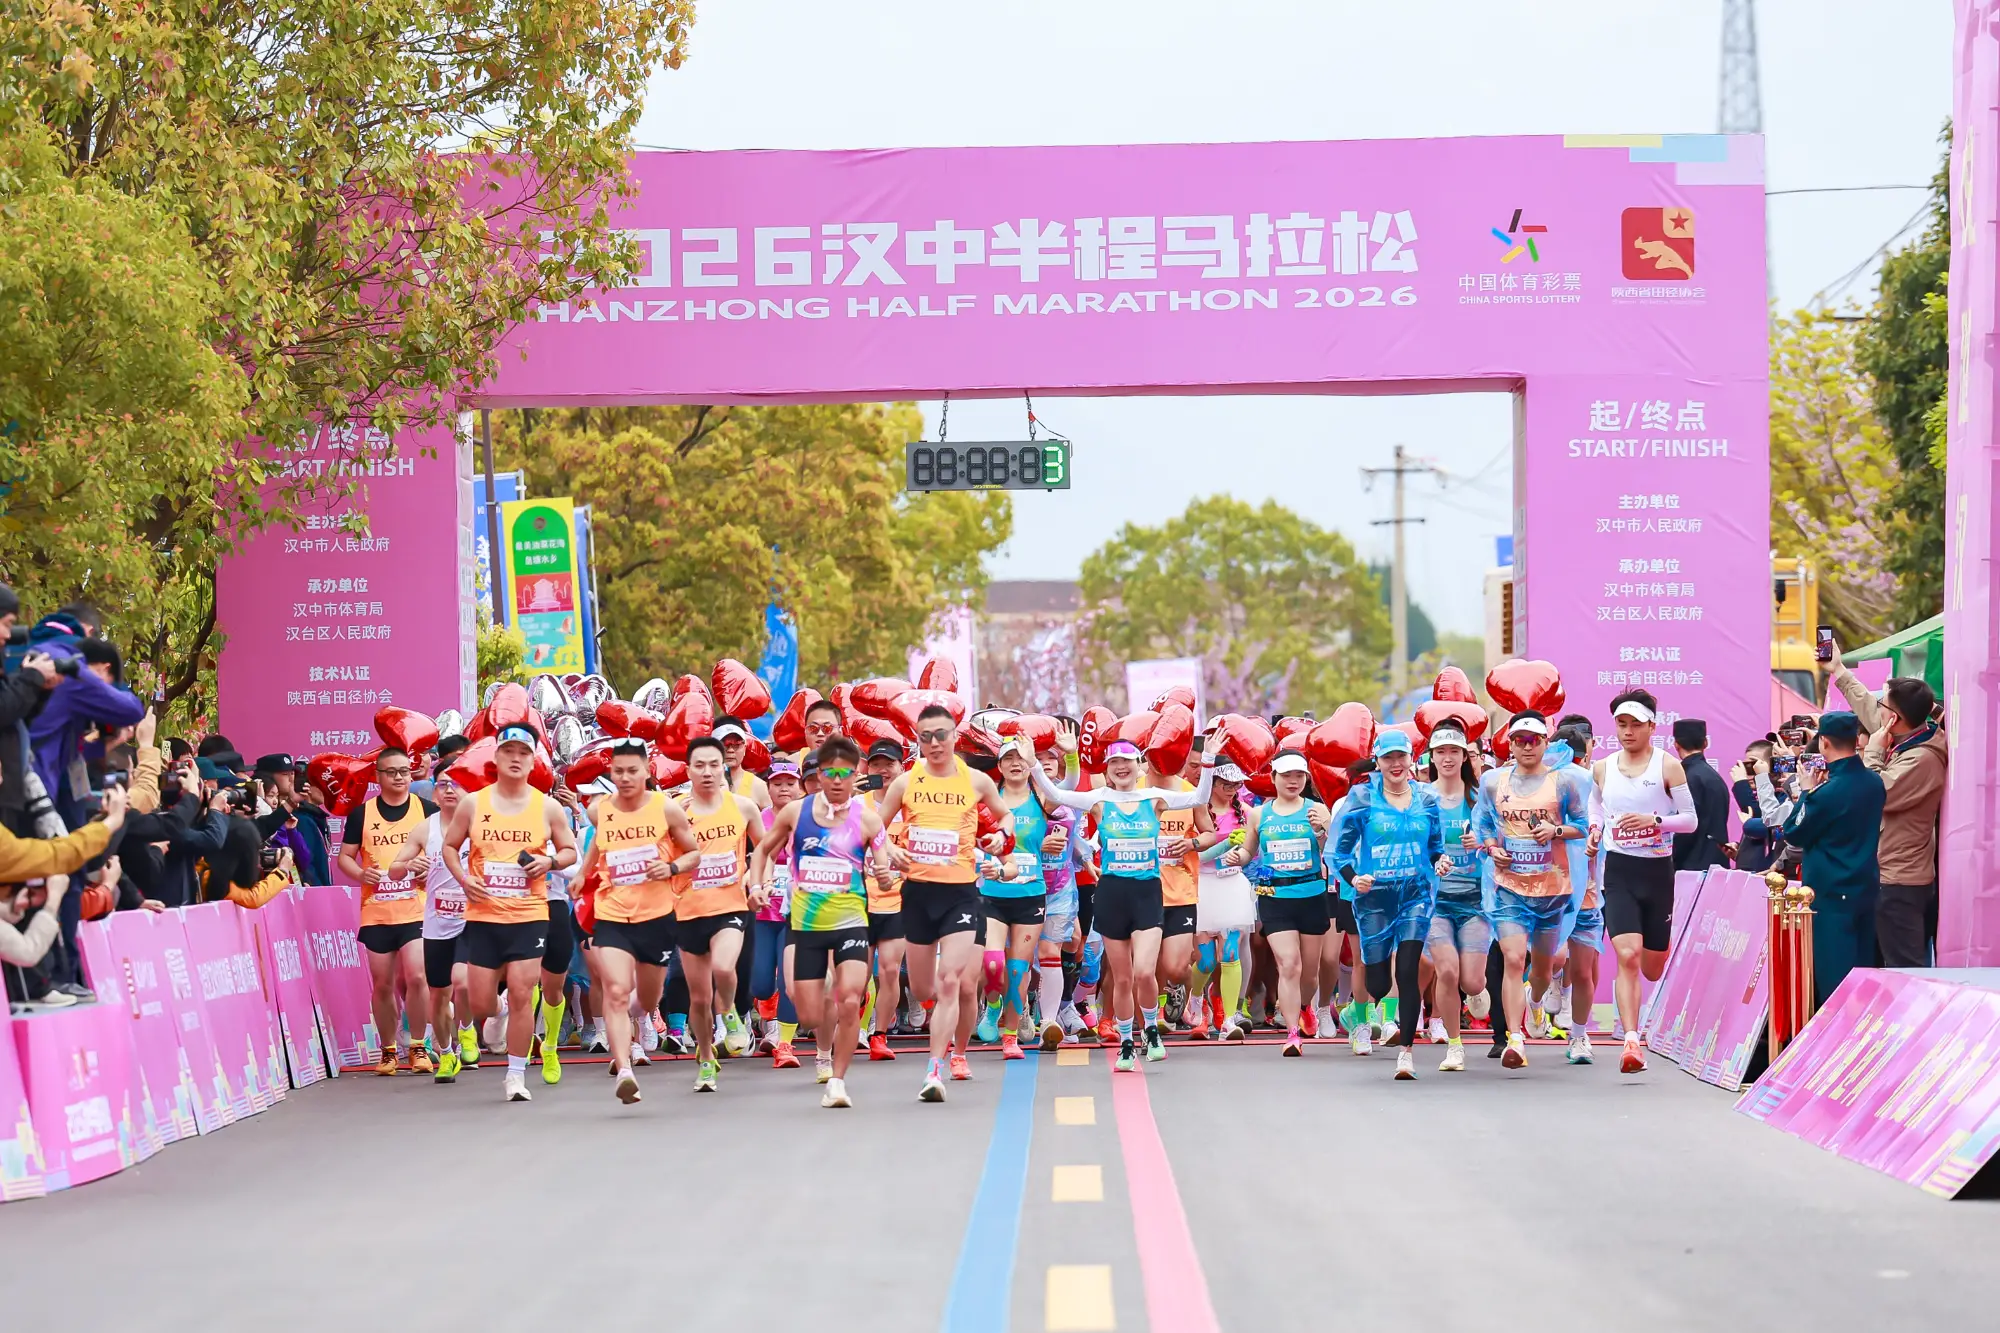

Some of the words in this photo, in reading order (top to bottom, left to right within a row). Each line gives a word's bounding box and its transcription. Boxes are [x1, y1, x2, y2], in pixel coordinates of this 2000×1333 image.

[1458, 272, 1582, 292] 中国体育彩票
[1459, 295, 1490, 304] CHINA
[1492, 295, 1533, 304] SPORTS
[1535, 295, 1581, 304] LOTTERY
[1611, 287, 1706, 298] 陕西省田径协会
[538, 298, 830, 323] HANZHONG
[847, 295, 977, 318] HALF
[993, 289, 1278, 315] MARATHON
[1294, 286, 1418, 309] 2026
[1588, 400, 1707, 432] 起/终点
[1568, 438, 1729, 458] START/FINISH
[263, 457, 414, 478] ART/FINISH
[1618, 494, 1680, 510] 主办单位
[306, 514, 366, 530] 主办
[1596, 518, 1702, 533] 汉中市人民政府
[284, 536, 390, 553] 汉中市人民政府
[1618, 559, 1681, 574] 承办单位
[307, 577, 368, 593] 承办单位
[1604, 582, 1695, 598] 汉中市体育局
[292, 601, 384, 618] 汉中市体育局
[1596, 606, 1703, 621] 汉台区人民政府
[286, 625, 392, 641] 汉台区人民政府
[1619, 647, 1681, 662] 技术认证
[309, 666, 371, 682] 技术认证
[1597, 671, 1704, 686] 陕西省田径协会
[287, 688, 393, 706] 陕西省田径协会
[898, 691, 948, 708] 1:45
[310, 730, 372, 746] 执行承办
[1080, 720, 1097, 765] 2:00
[913, 791, 966, 806] PACER
[1112, 820, 1150, 830] PACER
[1159, 820, 1185, 831] CER
[1268, 824, 1304, 833] PACER
[372, 832, 411, 846] PACE
[481, 829, 532, 843] PACER
[606, 825, 657, 842] PACER
[692, 824, 737, 843] ACER
[913, 842, 952, 854] A0012
[1115, 851, 1149, 861] B0013
[1274, 851, 1305, 862] B0935
[1511, 852, 1545, 862] A0017
[615, 861, 647, 875] A001
[697, 864, 734, 878] A0014
[489, 875, 526, 887] A2258
[804, 870, 844, 882] A0001
[377, 880, 411, 891] A0020
[439, 900, 465, 910] A073
[311, 929, 361, 971] 汉中市人民政府
